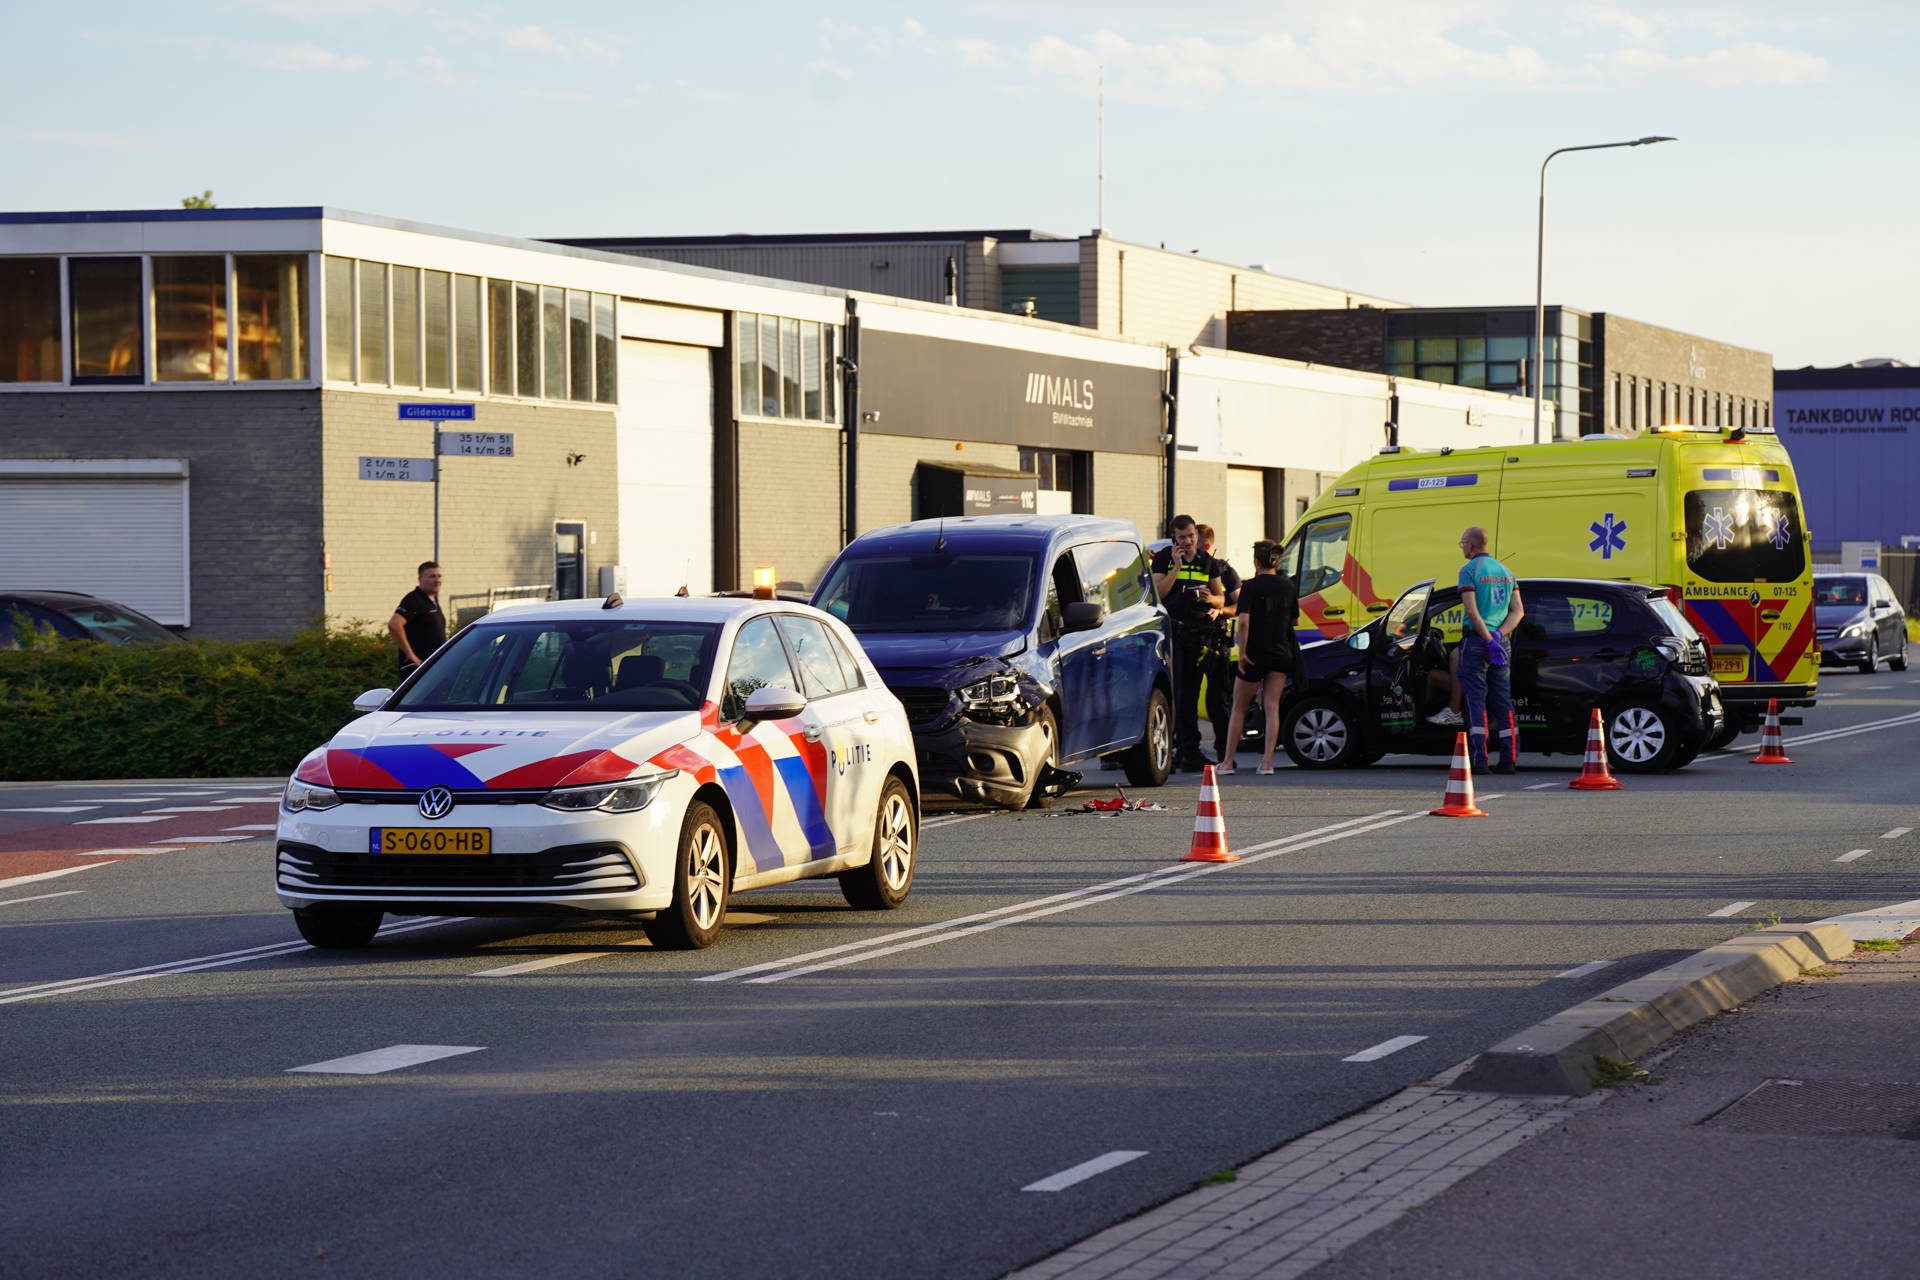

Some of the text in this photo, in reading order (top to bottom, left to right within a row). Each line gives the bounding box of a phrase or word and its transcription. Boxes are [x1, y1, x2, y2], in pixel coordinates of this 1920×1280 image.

[1046, 375, 1093, 410] MALS
[406, 406, 465, 417] Gildenstraat
[1786, 408, 1885, 423] TANKBOUW
[459, 434, 510, 443] 35 t/m 51
[461, 445, 512, 456] 14 t/m 28
[365, 458, 409, 468] 2 t/m 12
[375, 471, 395, 480] t/m
[399, 471, 410, 480] 21
[1420, 478, 1445, 487] 07-125
[1685, 586, 1749, 596] AMBULANCE
[1773, 587, 1797, 597] 07-125
[1782, 622, 1792, 631] 112
[412, 730, 550, 738] POLITIE
[385, 831, 484, 851] S-060-HB
